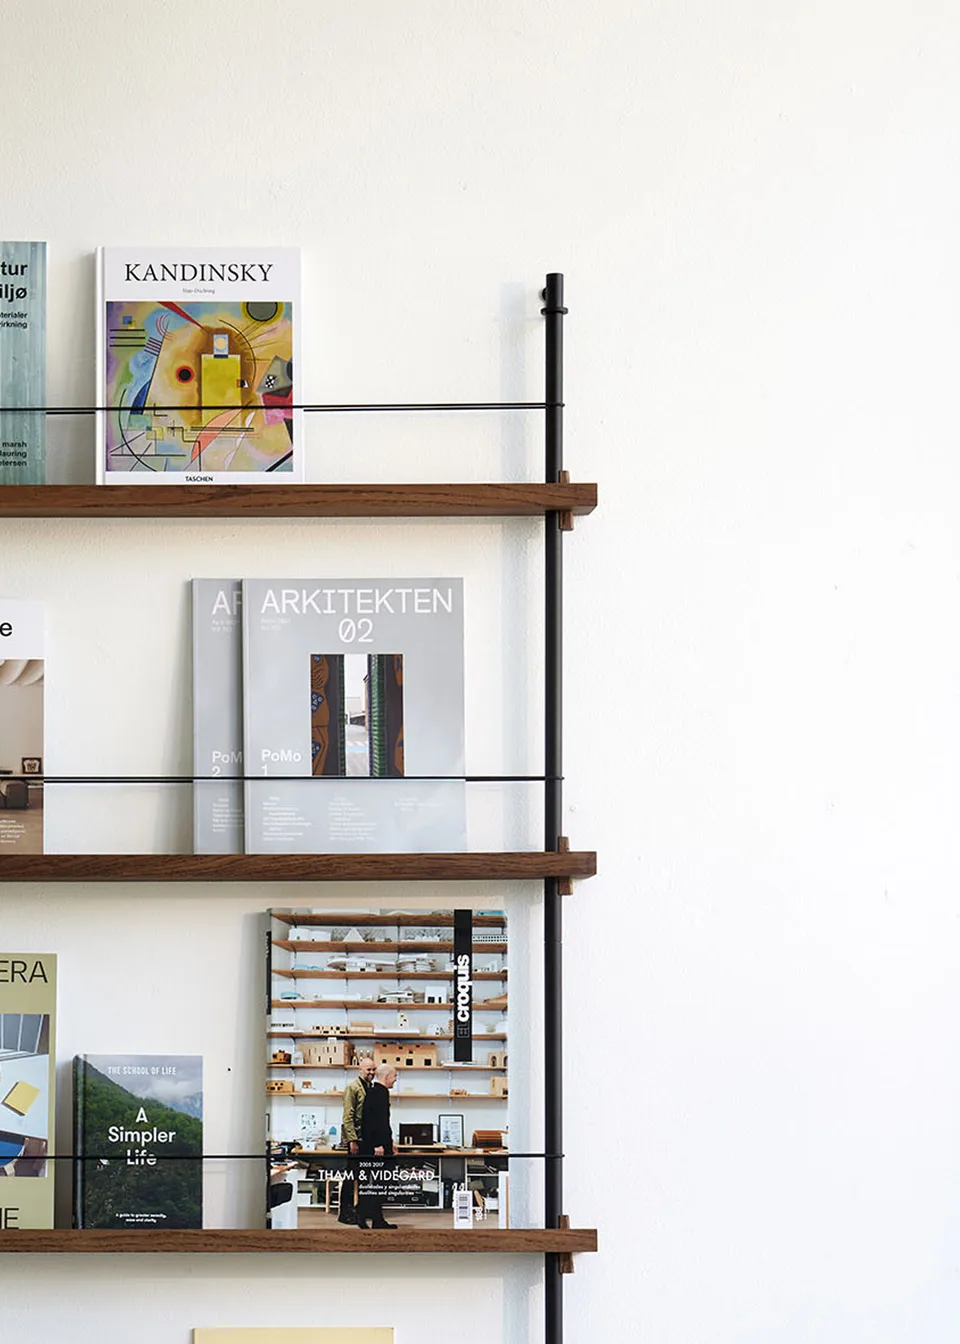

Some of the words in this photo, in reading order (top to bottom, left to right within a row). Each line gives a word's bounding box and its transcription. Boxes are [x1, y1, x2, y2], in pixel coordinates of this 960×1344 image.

[124, 263, 274, 282] KANDINSKY
[2, 440, 28, 448] marsh
[0, 449, 28, 459] lauring
[185, 475, 214, 483] TASCHEN
[260, 588, 453, 615] ARKITEKTEN
[261, 749, 302, 763] PoMo
[211, 765, 221, 778] 2
[453, 954, 473, 1022] croquis
[108, 1066, 121, 1075] THE
[122, 1066, 149, 1075] SCHOOL
[151, 1066, 160, 1075] OF
[161, 1066, 177, 1075] LIFE
[135, 1106, 148, 1123] A
[108, 1126, 177, 1147] Simpler
[126, 1149, 157, 1166] Life
[318, 1169, 355, 1181] THAM
[358, 1169, 368, 1181] &
